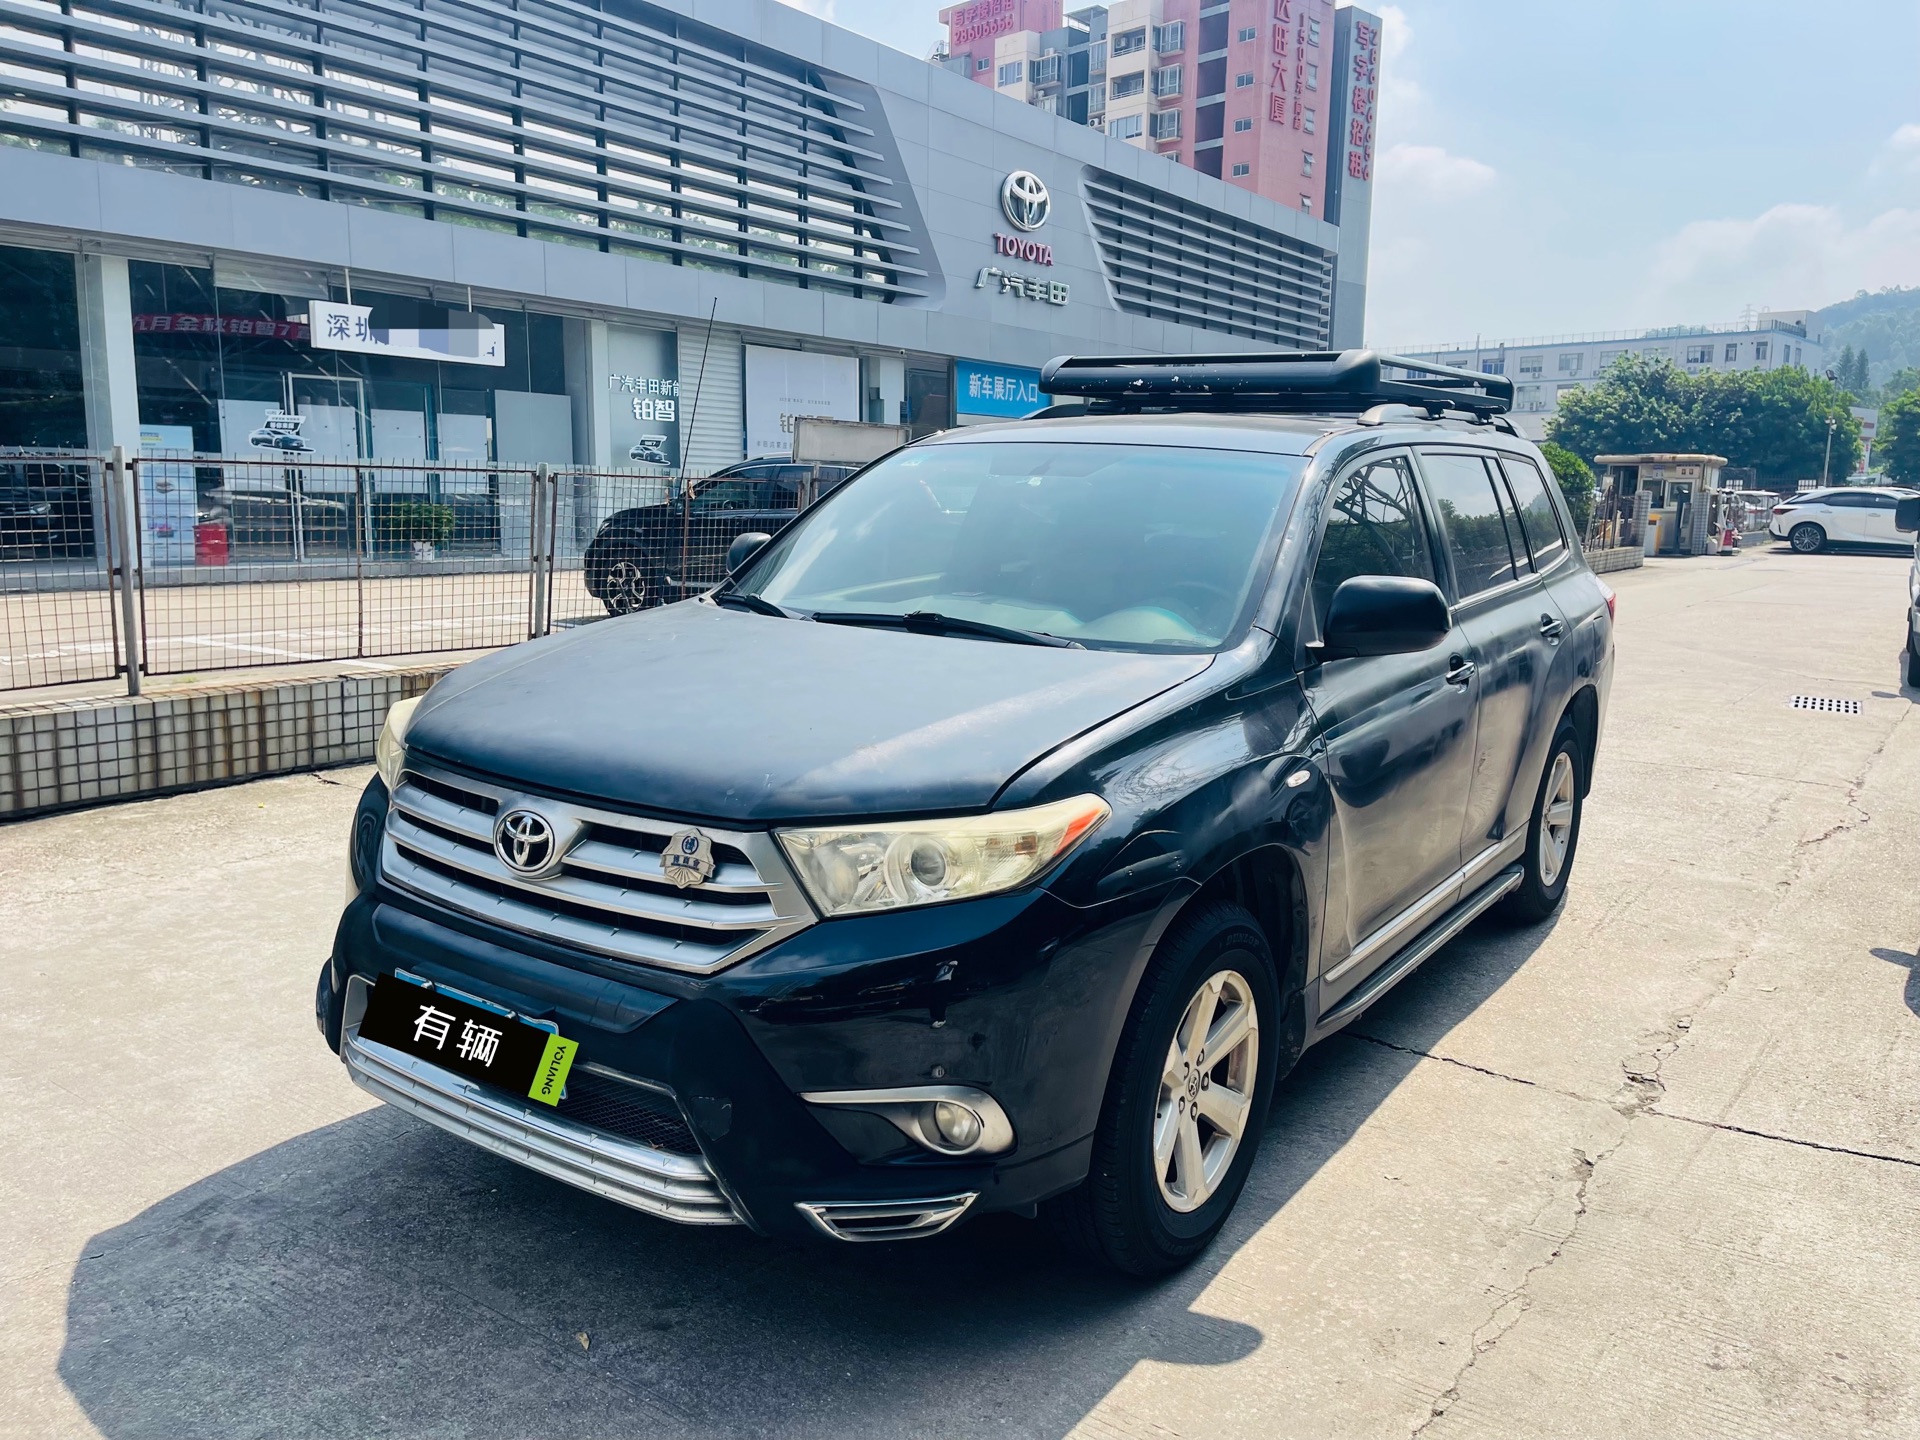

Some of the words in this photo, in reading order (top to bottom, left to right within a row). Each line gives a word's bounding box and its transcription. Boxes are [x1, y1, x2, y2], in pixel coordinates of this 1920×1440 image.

[1349, 21, 1369, 178] 写字楼招租
[993, 232, 1053, 267] TOYOTA
[975, 267, 1070, 306] 广汽丰田
[969, 373, 1038, 403] 新车展厅入口
[632, 397, 675, 422] 铂智
